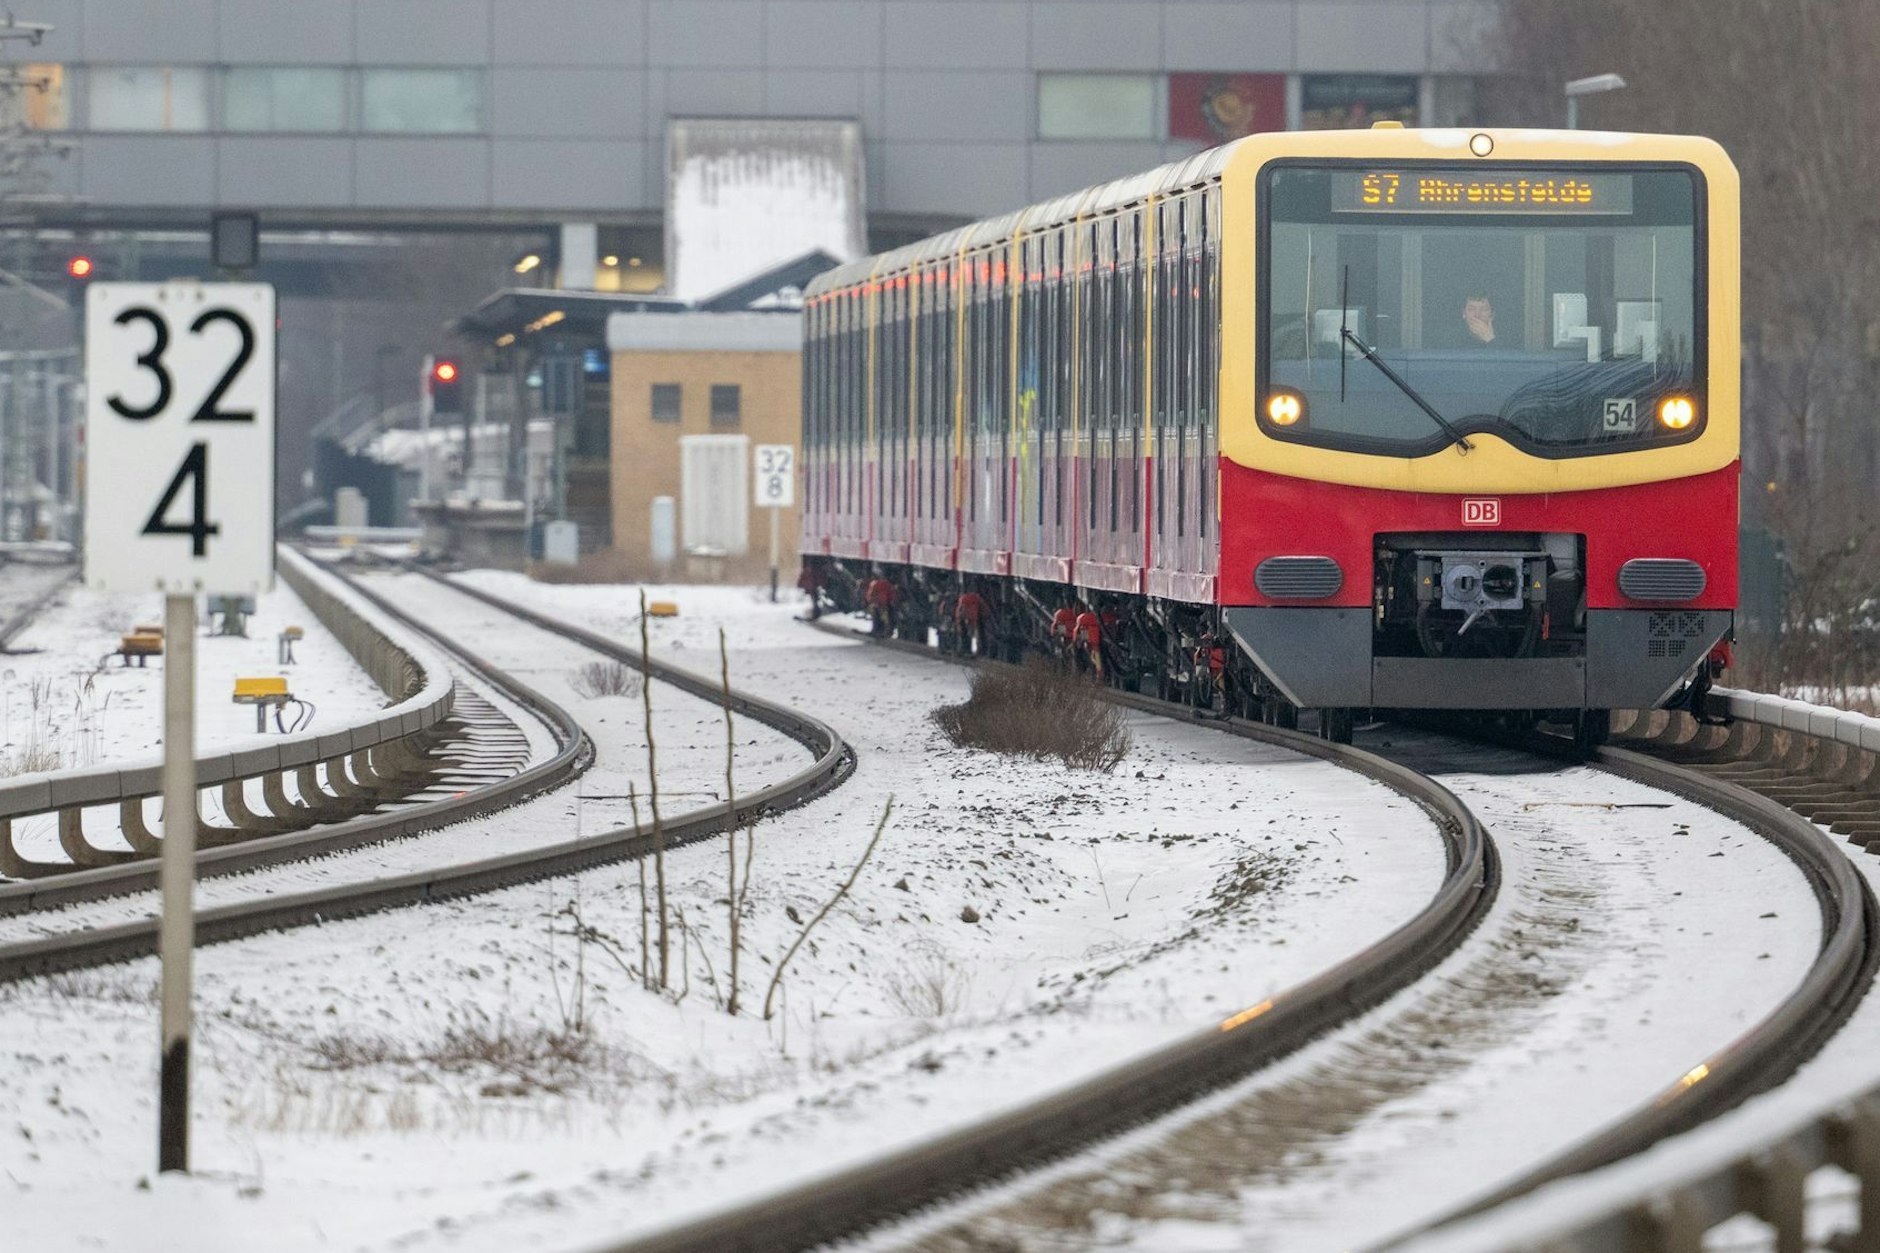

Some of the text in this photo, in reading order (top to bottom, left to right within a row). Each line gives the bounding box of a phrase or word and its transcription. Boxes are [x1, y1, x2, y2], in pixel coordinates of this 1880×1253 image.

[1362, 173, 1592, 203] S7 Ahrensfelde
[107, 306, 257, 422] 32
[1606, 402, 1634, 427] 54
[761, 449, 791, 473] 32
[140, 440, 221, 557] 4
[767, 475, 783, 498] 8
[1467, 502, 1496, 521] DB
